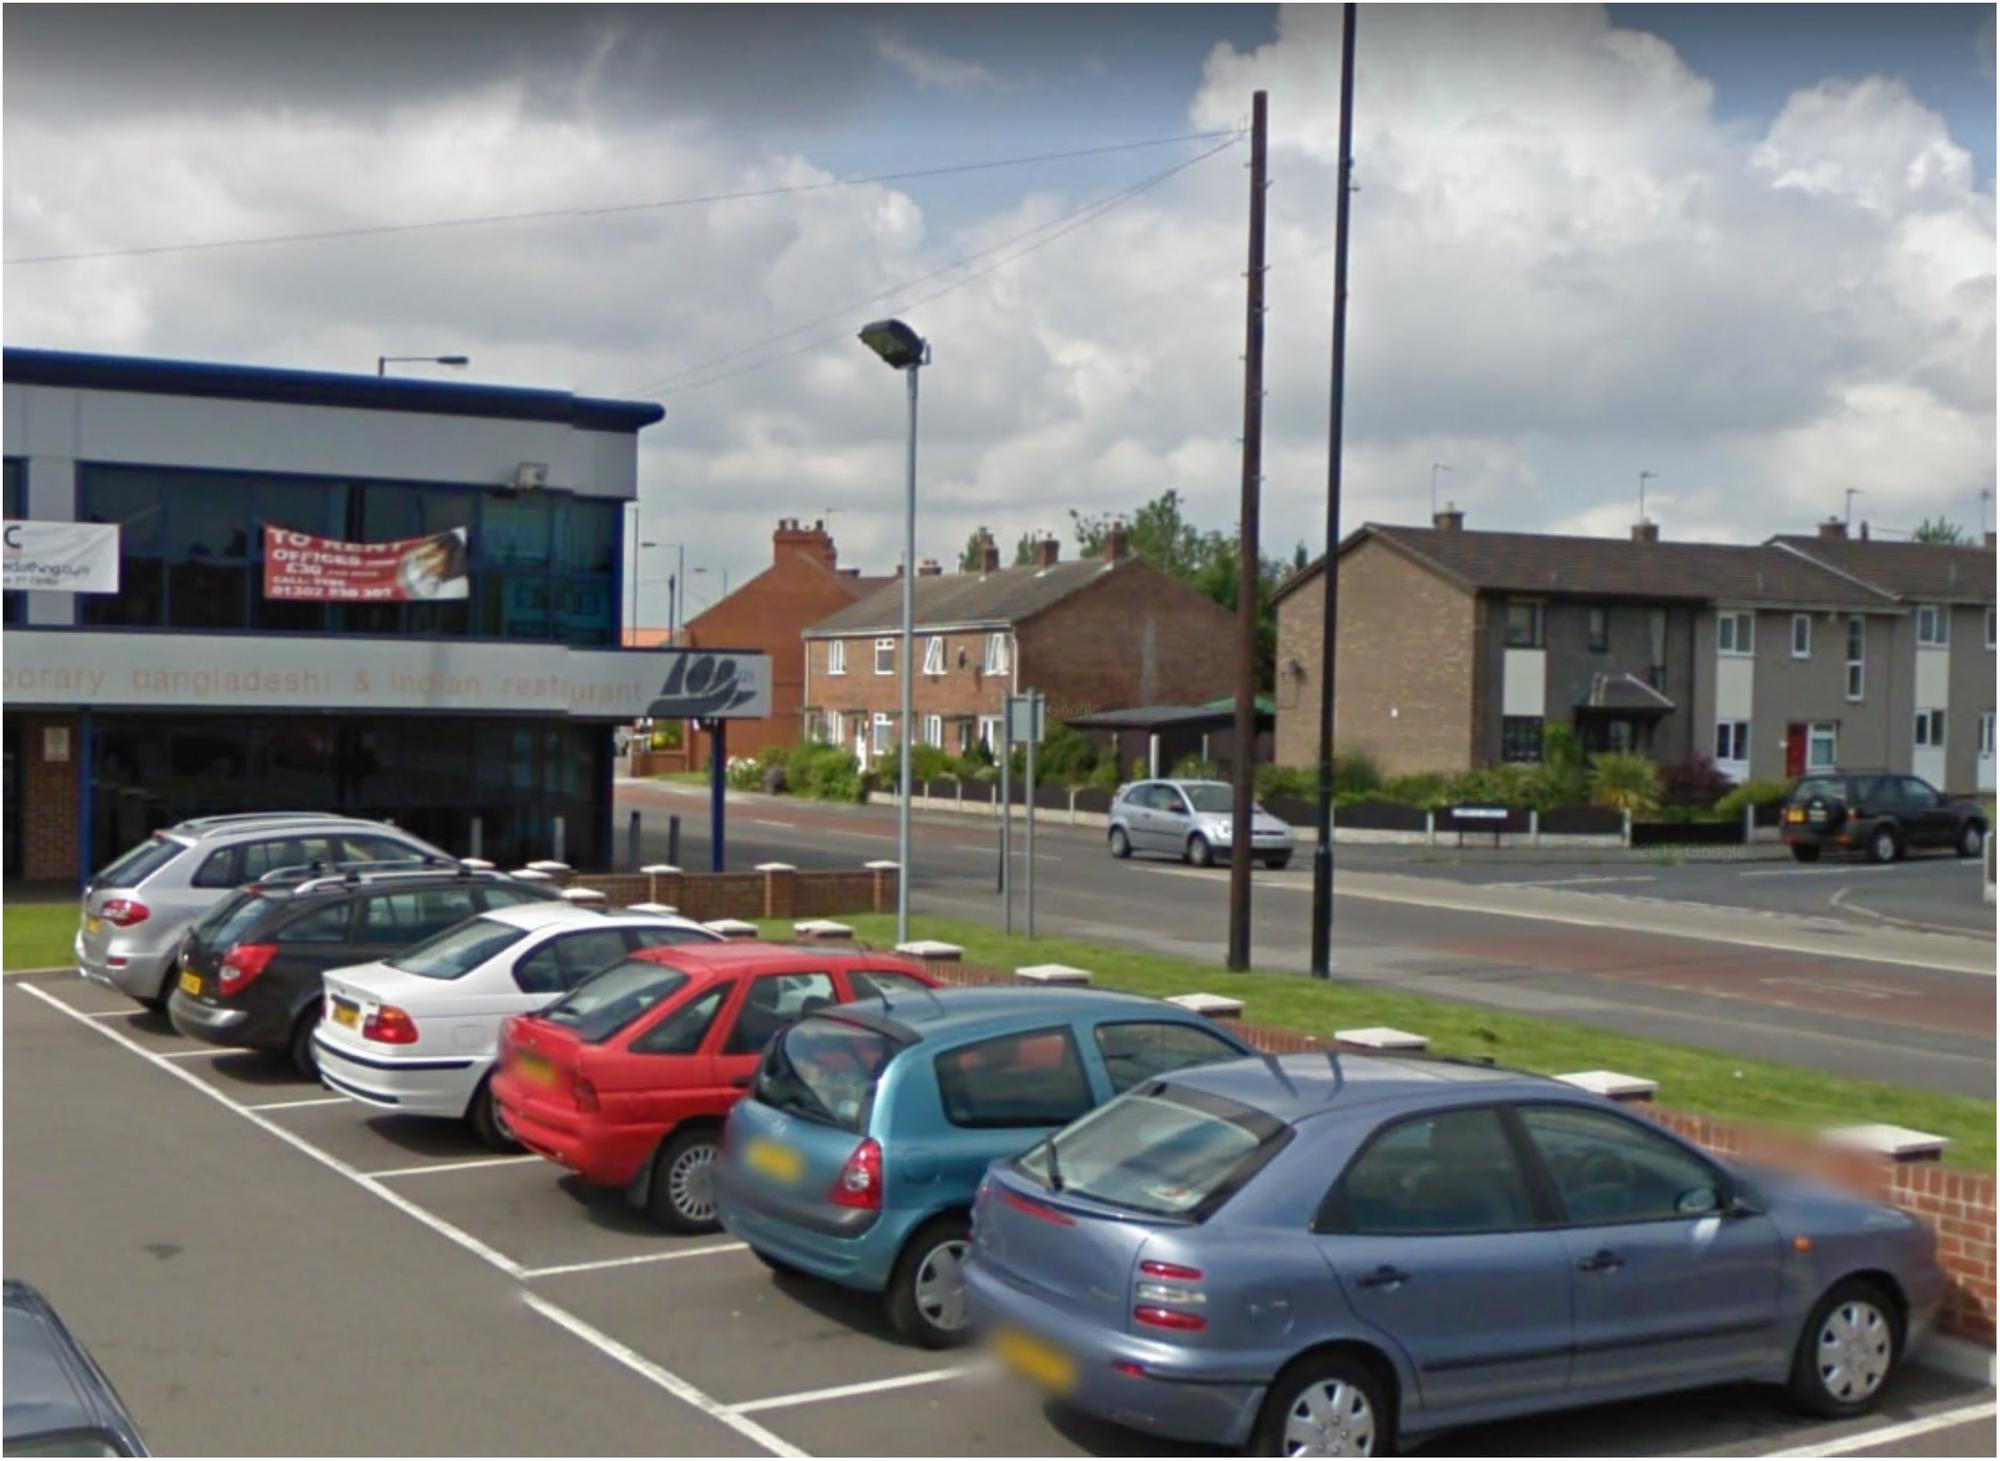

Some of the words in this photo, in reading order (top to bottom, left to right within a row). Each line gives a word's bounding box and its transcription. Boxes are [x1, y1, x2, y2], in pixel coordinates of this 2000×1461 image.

[268, 527, 311, 547] TO
[273, 549, 360, 566] OFFICES
[133, 666, 332, 696] bangladeshi
[354, 667, 369, 693] &
